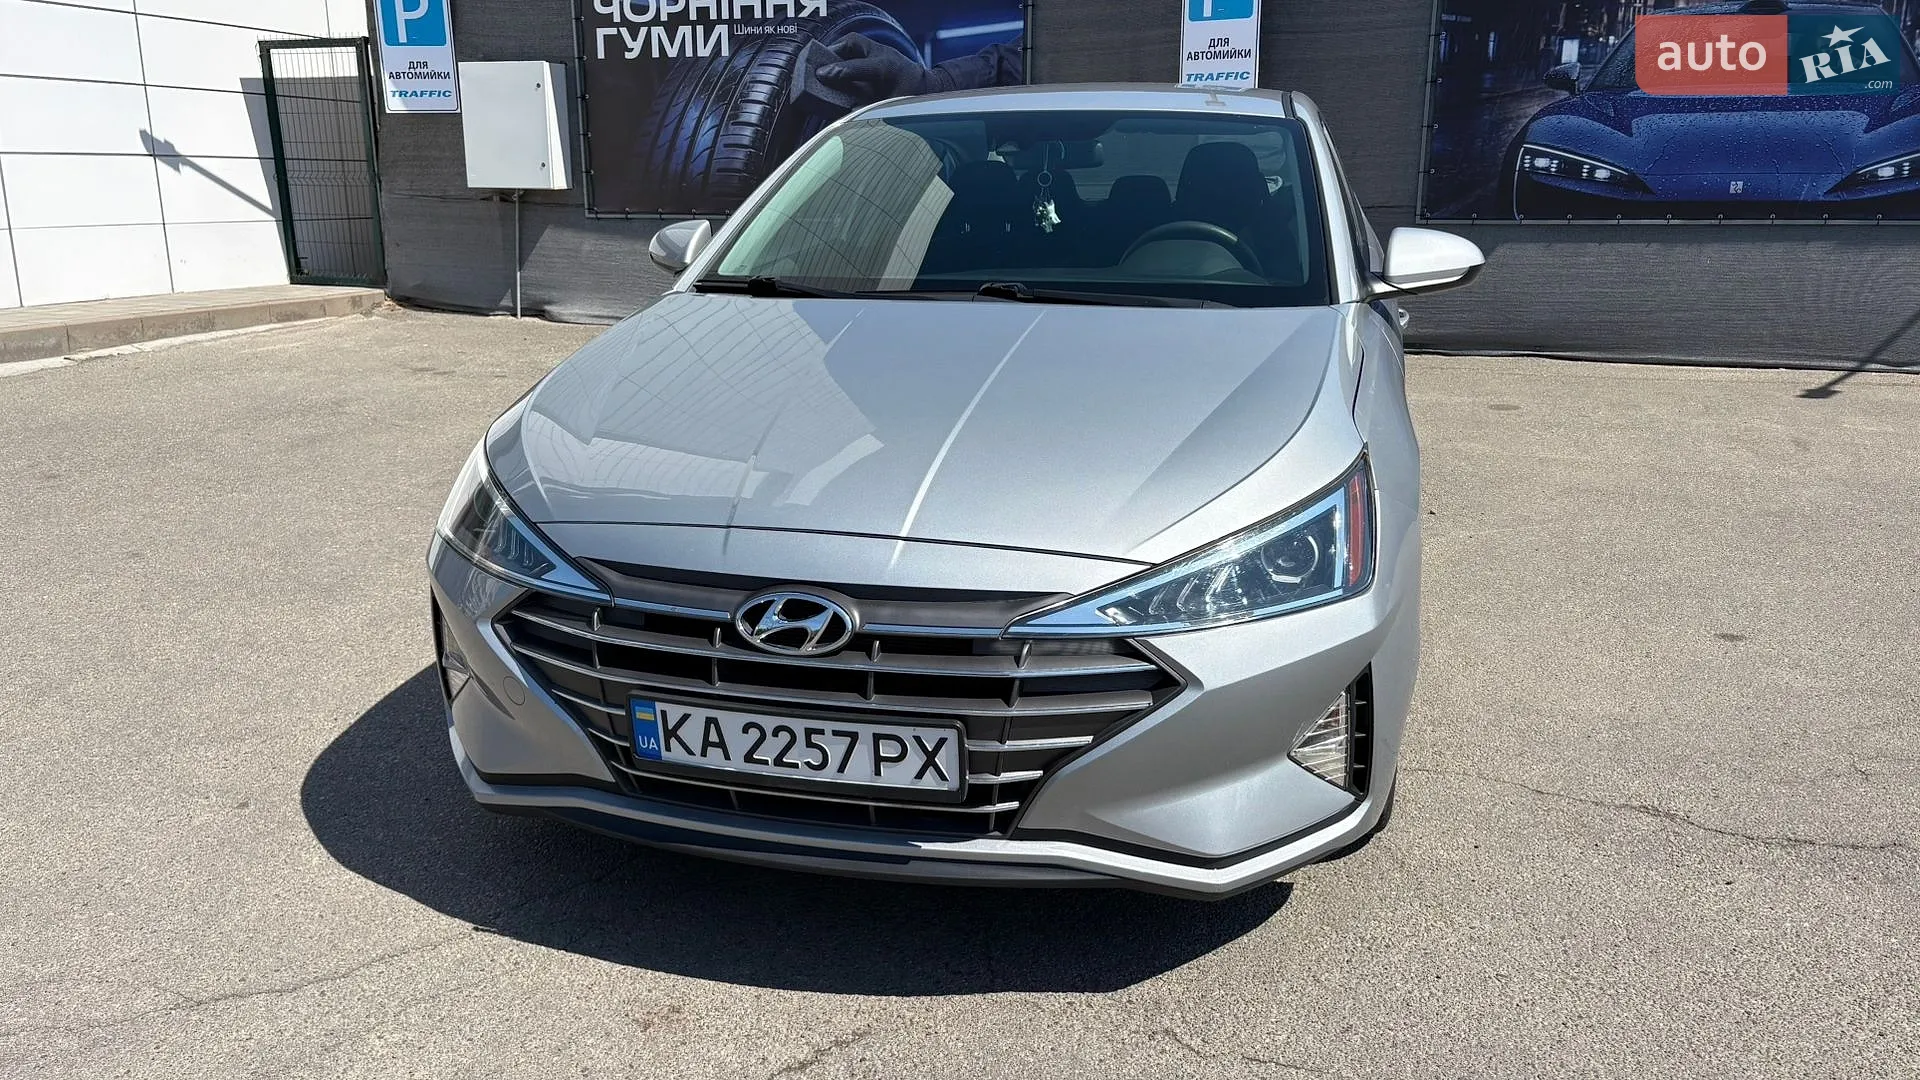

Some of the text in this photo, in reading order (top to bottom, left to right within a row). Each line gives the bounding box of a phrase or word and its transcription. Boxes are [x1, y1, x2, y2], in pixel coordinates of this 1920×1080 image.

[733, 22, 798, 36] Шини як нові
[595, 24, 730, 59] ГУМИ
[1208, 37, 1229, 49] ДЛЯ
[1187, 48, 1251, 61] АВТОМИЙКИ
[408, 61, 429, 71] ДЛЯ
[388, 70, 451, 80] АВТОМИЙКИ
[1186, 71, 1250, 82] TRAFFIC
[390, 90, 453, 98] TRAFFIC
[638, 734, 659, 751] UA
[660, 708, 950, 782] KA 2257 PX
